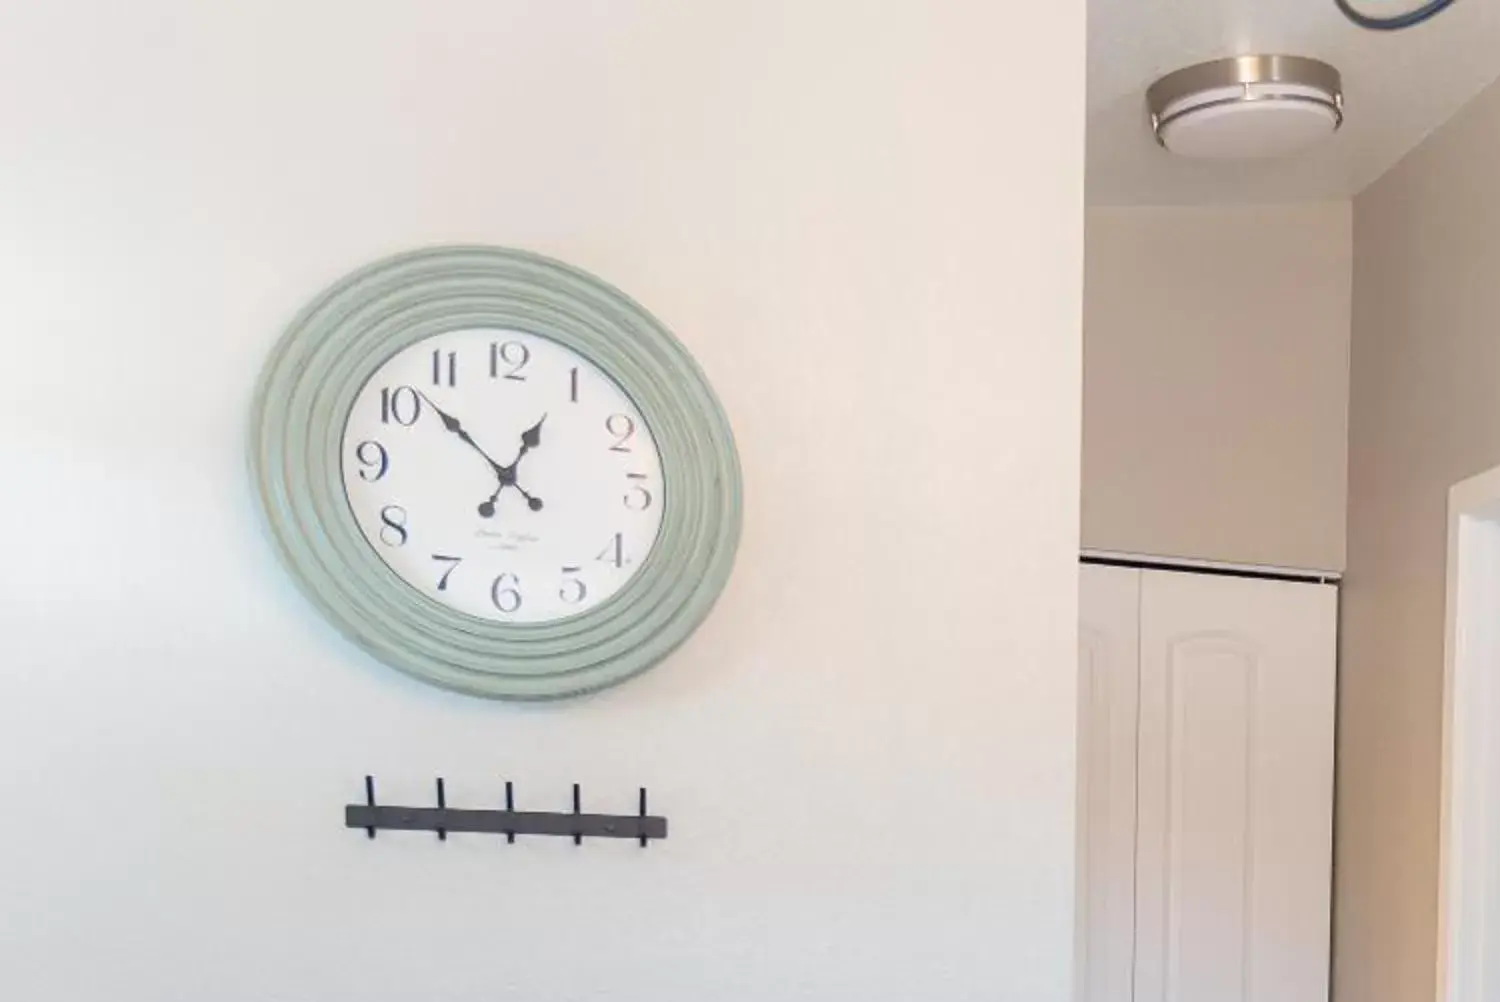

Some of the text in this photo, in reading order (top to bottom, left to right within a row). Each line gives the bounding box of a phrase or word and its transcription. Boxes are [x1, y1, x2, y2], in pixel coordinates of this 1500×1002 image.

[432, 349, 456, 387] 11
[489, 340, 530, 381] 12
[570, 367, 578, 403] 1
[381, 385, 421, 426] 10
[605, 413, 635, 452] 2
[355, 440, 389, 482] 9
[623, 472, 652, 511] 3
[379, 505, 407, 547] 8
[595, 532, 632, 568] 4
[431, 554, 462, 591] 7
[559, 566, 586, 604] 5
[491, 572, 522, 613] 6
